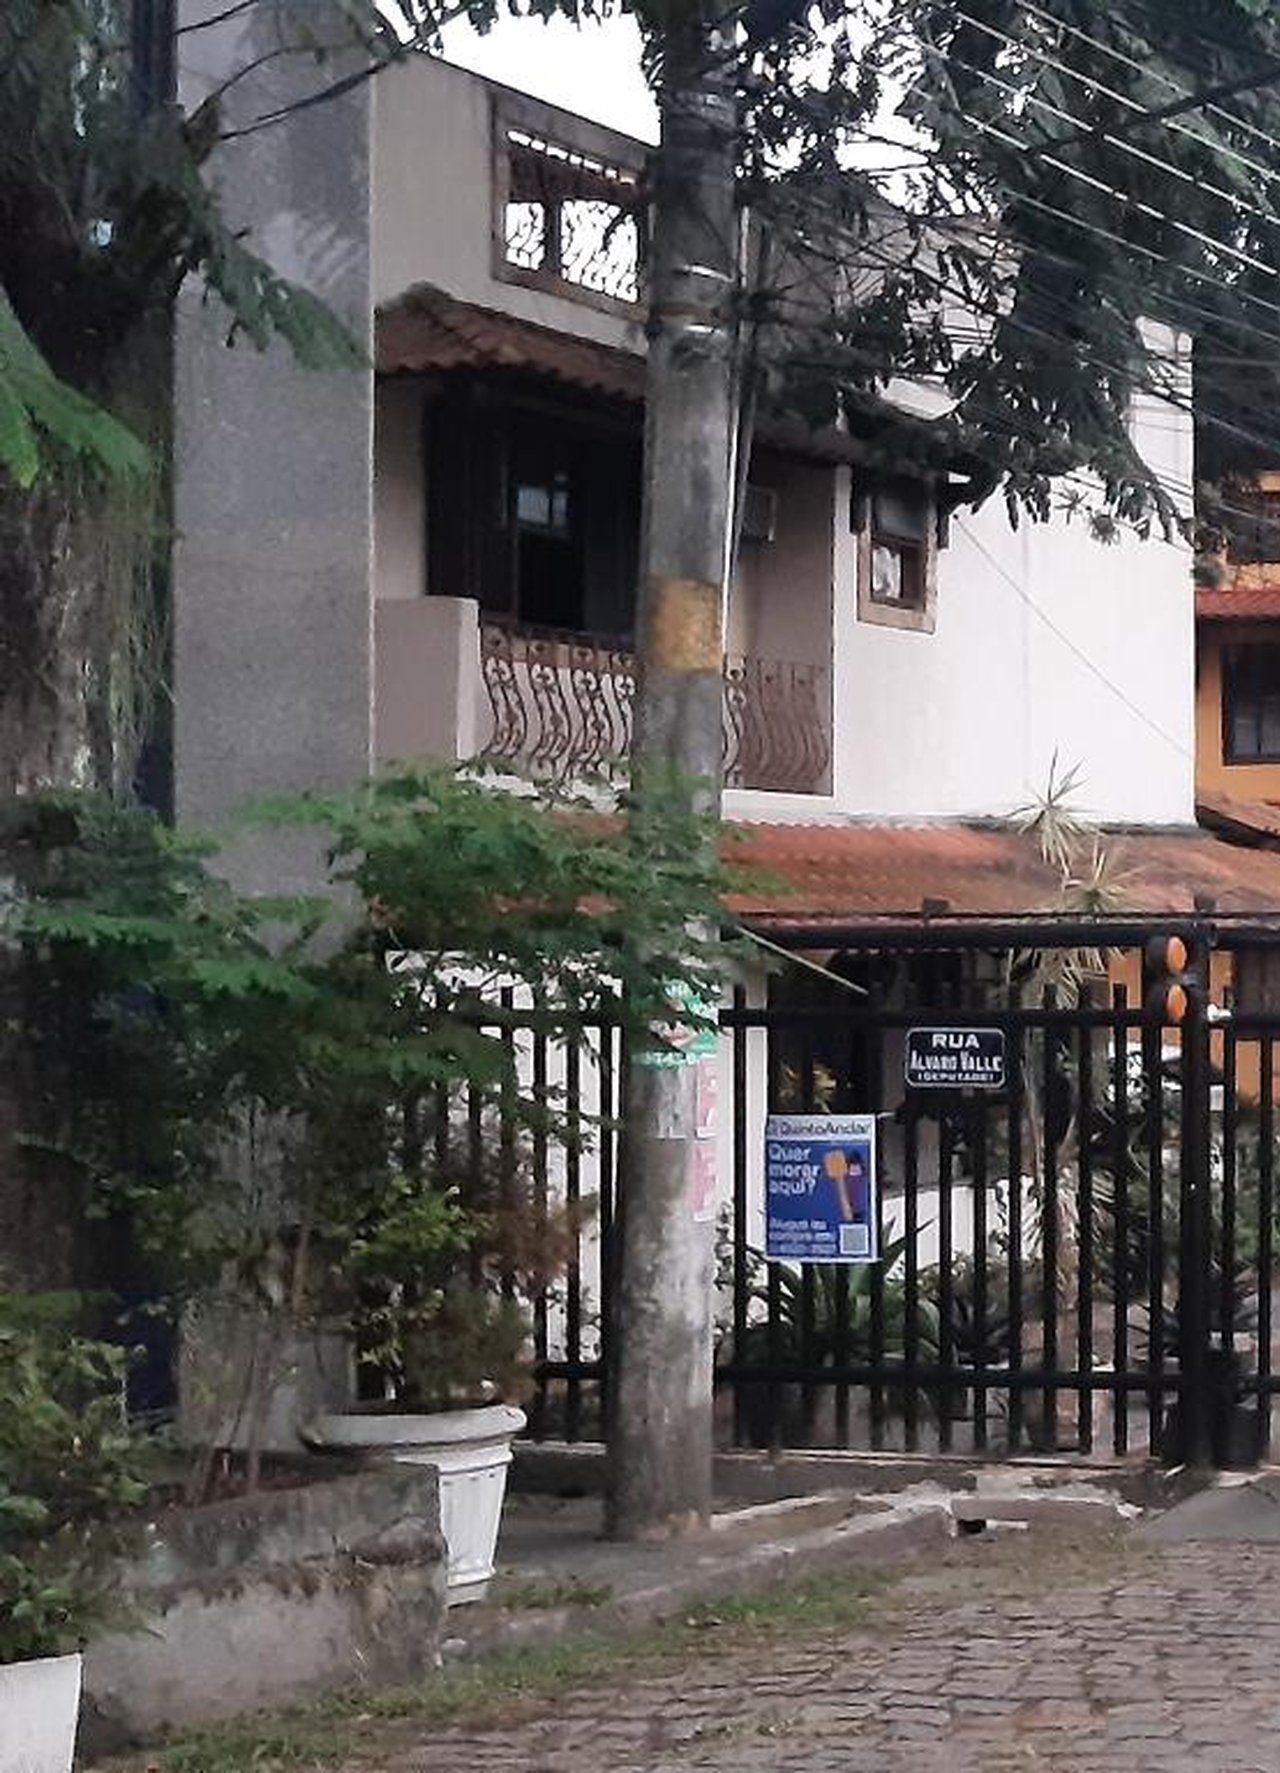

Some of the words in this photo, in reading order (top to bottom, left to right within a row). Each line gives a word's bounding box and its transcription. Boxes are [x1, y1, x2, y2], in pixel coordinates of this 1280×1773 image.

[932, 1034, 979, 1049] RUA
[960, 1051, 1002, 1071] VALLE
[768, 1143, 811, 1161] Quer
[768, 1164, 820, 1179] morar
[768, 1179, 816, 1196] aqui?
